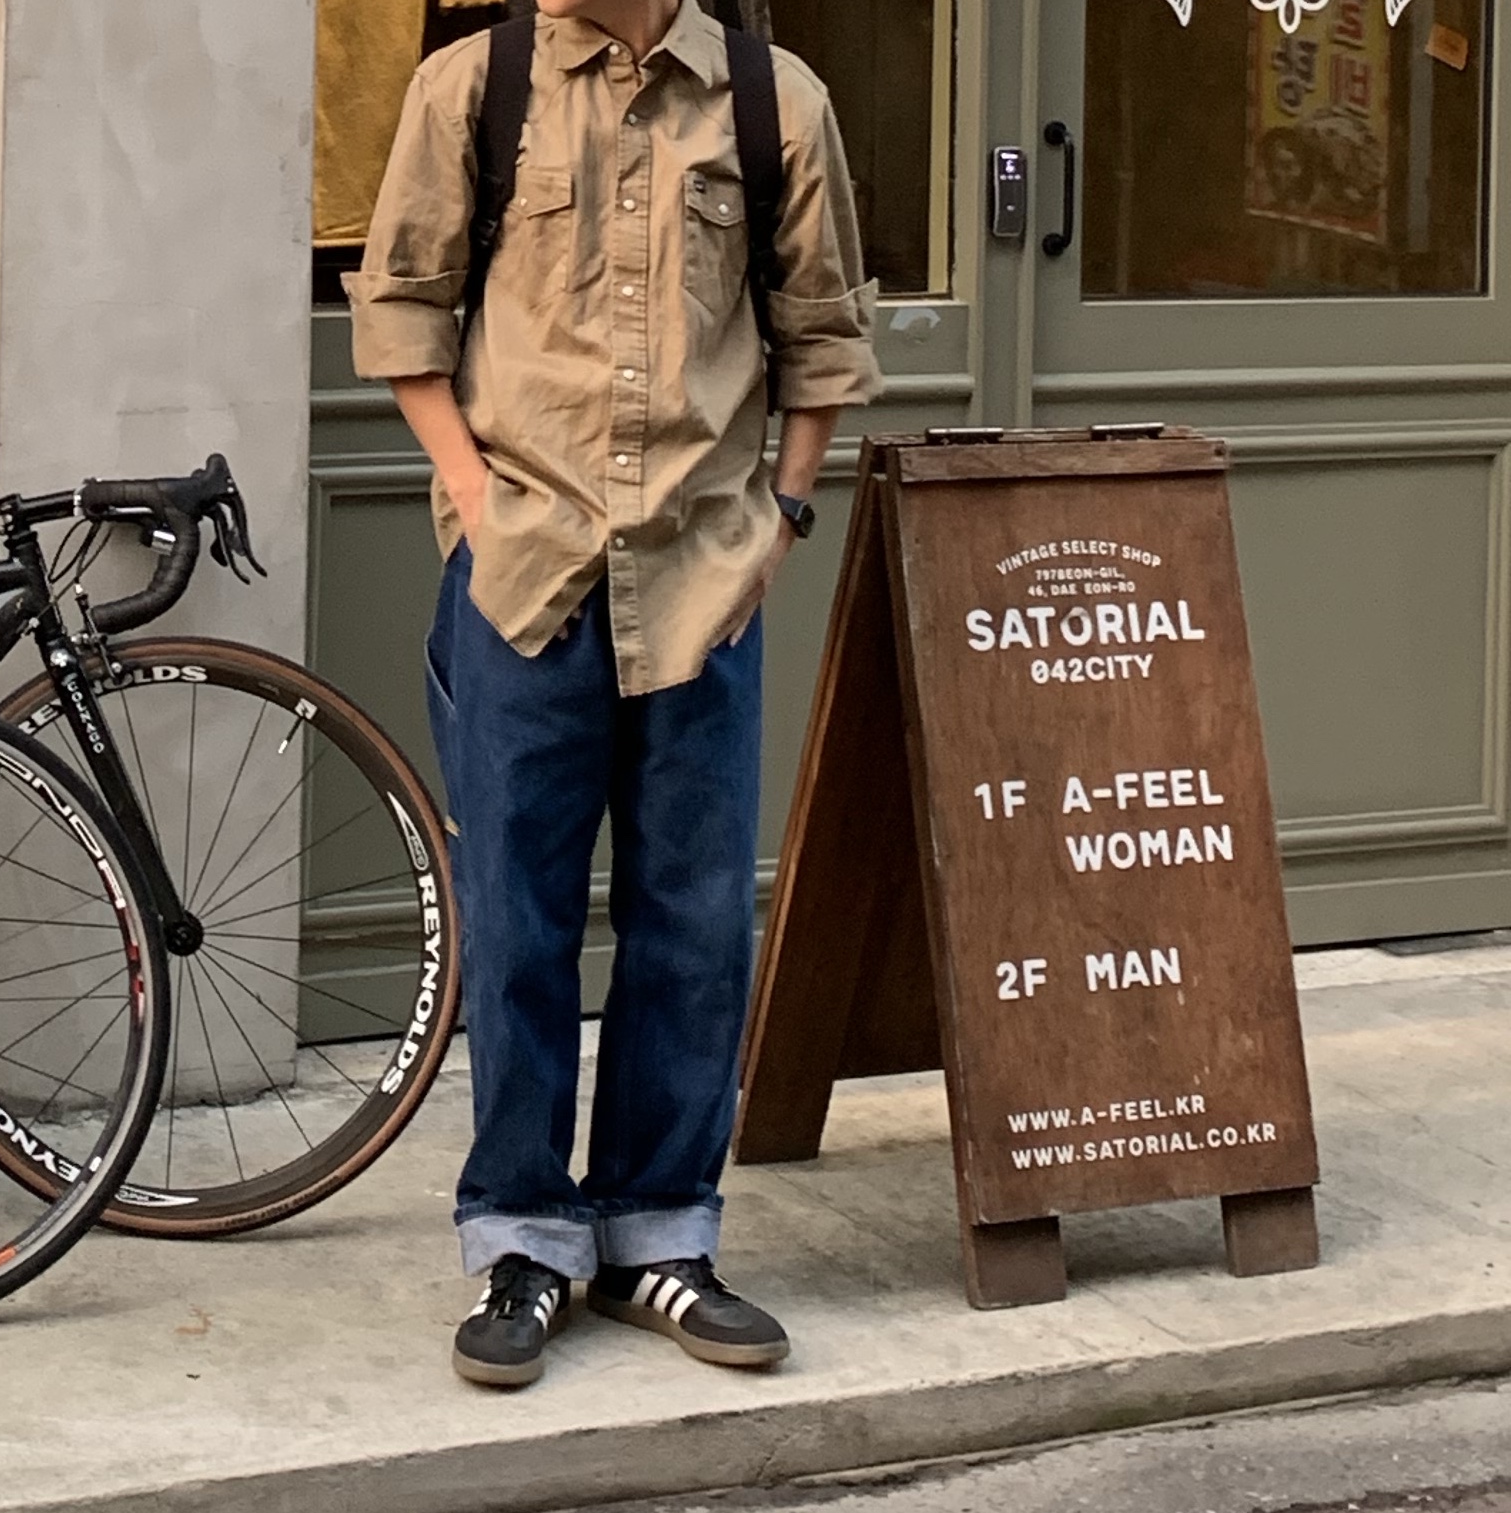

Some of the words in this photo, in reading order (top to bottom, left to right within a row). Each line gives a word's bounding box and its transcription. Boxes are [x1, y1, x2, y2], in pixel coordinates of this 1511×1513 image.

[995, 542, 1059, 575] VINTAGE
[1061, 540, 1118, 556] SELECT
[1121, 545, 1162, 568] SHOP
[965, 600, 1205, 652] SATORIAL
[1031, 653, 1155, 685] 042CITY
[66, 681, 105, 754] COLNAGO
[974, 780, 1027, 819] 1F
[1062, 769, 1224, 814] A-FEEL
[1066, 824, 1234, 873] WOMAN
[381, 872, 440, 1095] REYNOLDS
[996, 958, 1048, 1000] 2F
[1085, 947, 1182, 992] MAN
[1008, 1094, 1206, 1134] WWW.A-FEEL.KR
[1011, 1122, 1277, 1170] WWW.SATORIAL.CO.KR
